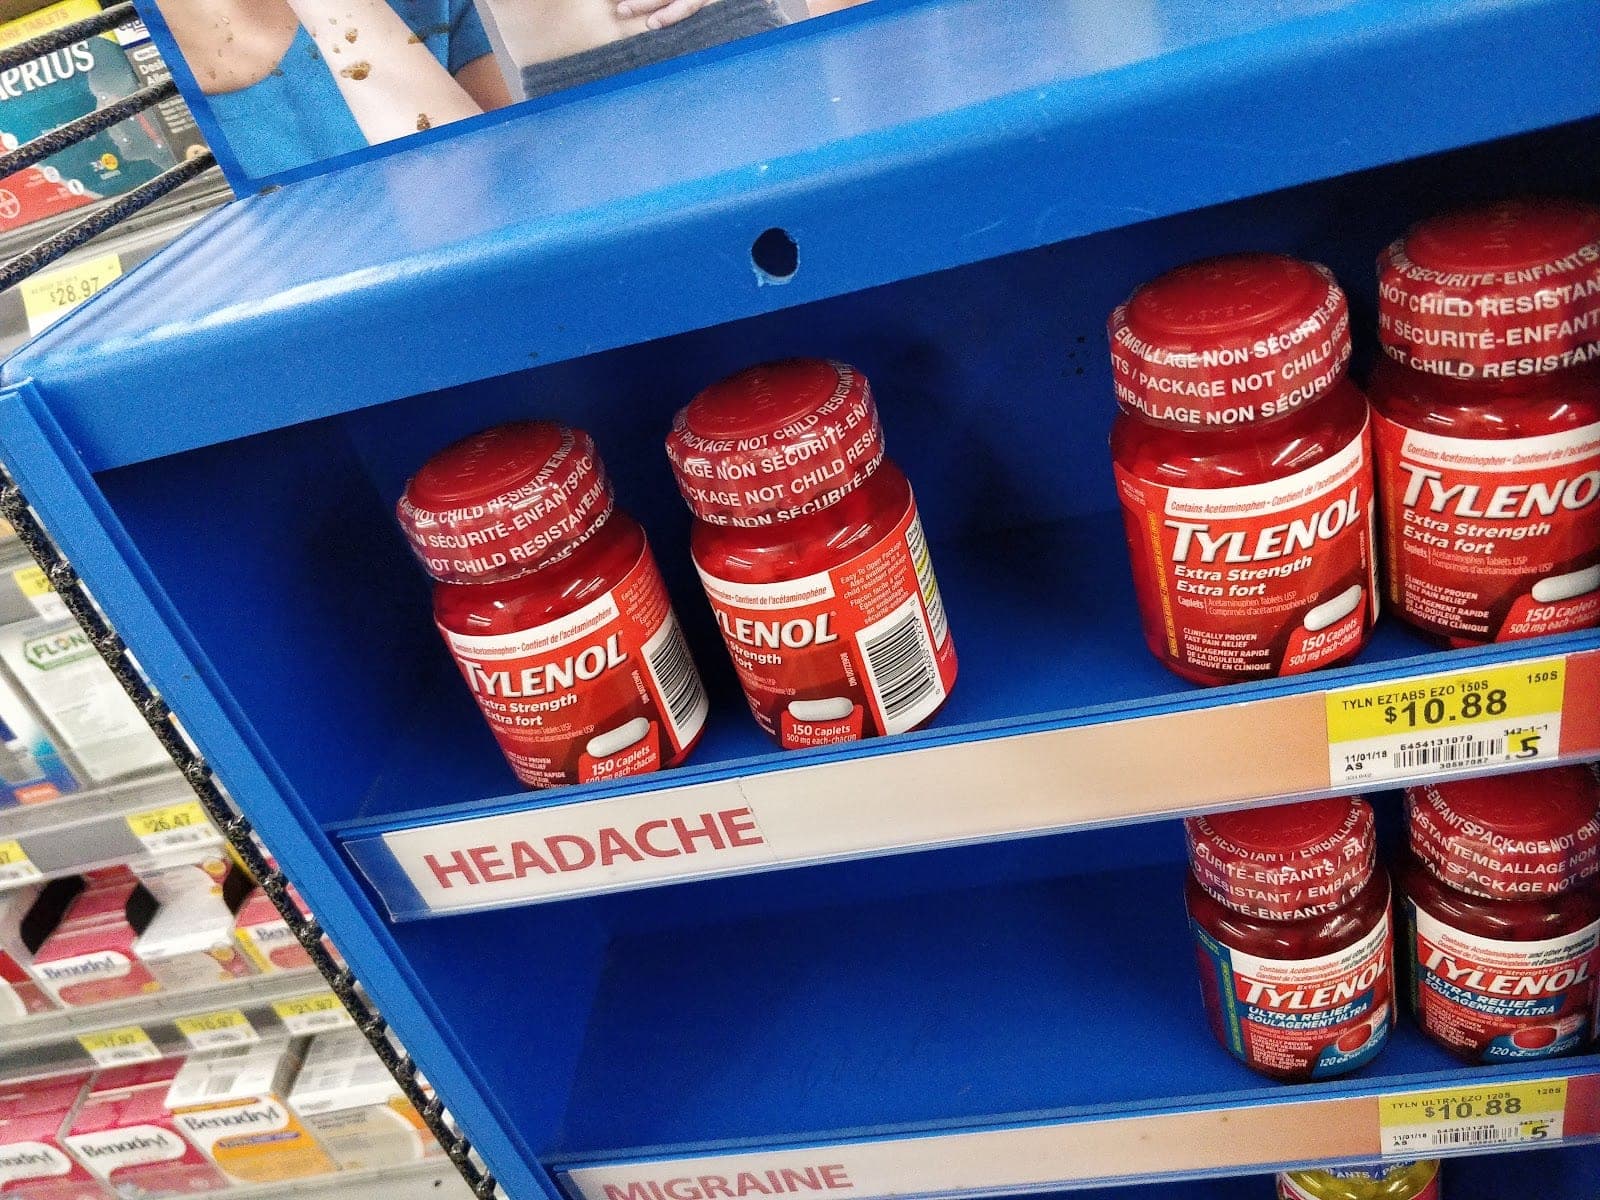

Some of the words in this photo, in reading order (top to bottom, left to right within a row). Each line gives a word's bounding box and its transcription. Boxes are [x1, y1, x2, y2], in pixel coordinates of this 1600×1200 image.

[1379, 280, 1408, 306] NOT
[1409, 294, 1474, 317] CHILD
[1115, 325, 1199, 368] EMBALLAGE
[1202, 349, 1249, 368] NON
[1139, 373, 1225, 397] PACKAGE
[1231, 369, 1276, 394] NOT
[1281, 339, 1332, 380] CHILD
[1411, 357, 1475, 378] CHILD
[1206, 405, 1254, 425] NON
[737, 434, 770, 451] NOT
[773, 414, 820, 440] CHILD
[717, 461, 757, 480] NON
[745, 485, 785, 505] NOT
[791, 459, 846, 494] CHILD
[1399, 461, 1600, 519] TYLENO
[1171, 500, 1204, 514] Contains
[1204, 502, 1266, 514] Acetaminophen
[1271, 490, 1303, 507] Contient
[1304, 486, 1313, 498] de
[439, 504, 484, 524] CHILD
[1164, 487, 1361, 563] TYLENOL
[1403, 508, 1450, 533] Extra
[1454, 522, 1551, 540] Strength
[1403, 525, 1450, 548] Extra
[1454, 539, 1495, 555] fort
[454, 553, 507, 574] CHILD
[1175, 564, 1222, 582] Extra
[1226, 554, 1312, 582] Strength
[1513, 556, 1528, 566] USP
[840, 572, 857, 584] Easy
[843, 587, 861, 599] child
[861, 570, 887, 592] resistant
[1176, 580, 1223, 596] Extra
[1229, 581, 1267, 597] fort
[1404, 574, 1443, 594] CLINICALLY
[1444, 587, 1478, 600] PROVEN
[1284, 590, 1297, 602] USP
[1306, 591, 1319, 604] USP
[1405, 582, 1420, 593] FAST
[1420, 586, 1439, 599] PAIN
[1439, 594, 1467, 606] RELIEF
[1458, 607, 1490, 618] RAPIDE
[1526, 606, 1555, 623] 150
[1556, 601, 1597, 618] Caplets
[1184, 627, 1224, 641] CLINICALLY
[1224, 632, 1257, 641] PROVEN
[1302, 634, 1326, 652] 150
[1326, 618, 1358, 643] Caplets
[1437, 618, 1448, 627] EN
[1449, 621, 1490, 633] CLINIQUE
[1509, 622, 1529, 634] 500
[1531, 622, 1545, 633] mg
[1184, 634, 1200, 643] FAST
[1200, 636, 1221, 647] PAIN
[1221, 639, 1248, 648] RELIEF
[1186, 643, 1239, 657] SOULAGEMENT
[1240, 649, 1270, 657] RAPIDE
[457, 632, 628, 698] TYLENOL
[1187, 650, 1196, 658] DE
[1197, 651, 1207, 659] LA
[1289, 654, 1307, 667] 500
[1307, 649, 1320, 662] mg
[1222, 662, 1232, 670] EN
[1234, 663, 1271, 671] CLINIQUE
[1527, 671, 1558, 684] 150S
[509, 692, 578, 714] Strength
[1342, 697, 1373, 711] TYLN
[1377, 689, 1426, 706] EZTABS
[1430, 684, 1455, 698] EZO
[1460, 680, 1489, 693] 150S
[1384, 689, 1507, 727] $10.88
[515, 714, 543, 727] fort
[792, 723, 813, 736] 150
[815, 724, 851, 737] Caplets
[786, 733, 800, 743] 500
[800, 735, 811, 746] mg
[1515, 735, 1541, 759] 5
[592, 759, 614, 777] 150
[616, 745, 651, 769] Caplets
[1344, 750, 1388, 763] 11/01/18
[1345, 761, 1363, 772] AS
[1300, 807, 1362, 859] EMBALLAGE
[1549, 834, 1575, 853] NOT
[423, 807, 764, 889] HEADACHE
[1459, 845, 1566, 875] EMBALLAGE
[1569, 845, 1598, 869] NON
[1205, 869, 1291, 904] RESISTANT
[1547, 873, 1578, 893] NOT
[1423, 941, 1590, 996] TYLENOL
[1476, 964, 1505, 974] Extra
[1240, 950, 1386, 1010] TYLENOL
[1426, 971, 1474, 998] ULTRA
[1476, 994, 1537, 1009] RELIEF
[1424, 978, 1513, 1016] SOULAGEMENT
[1515, 1005, 1555, 1017] ULTRA
[1248, 1013, 1336, 1029] SOULAGEMENT
[1336, 1002, 1368, 1023] ULTRA
[1249, 1006, 1297, 1022] ULTRA
[1301, 1002, 1353, 1021] RELIEF
[1490, 1046, 1509, 1056] 120
[1320, 1058, 1336, 1067] 120
[1392, 1101, 1418, 1110] TYLN
[1422, 1096, 1457, 1107] ULTRA
[1461, 1094, 1482, 1102] EZO
[1537, 1087, 1561, 1096] 120S
[184, 1104, 280, 1132] Benadryl
[1424, 1097, 1522, 1120] $10.88
[1531, 1124, 1550, 1139] 5
[80, 1133, 170, 1158] Benadryl
[602, 1163, 854, 1200] MIGRAINE
